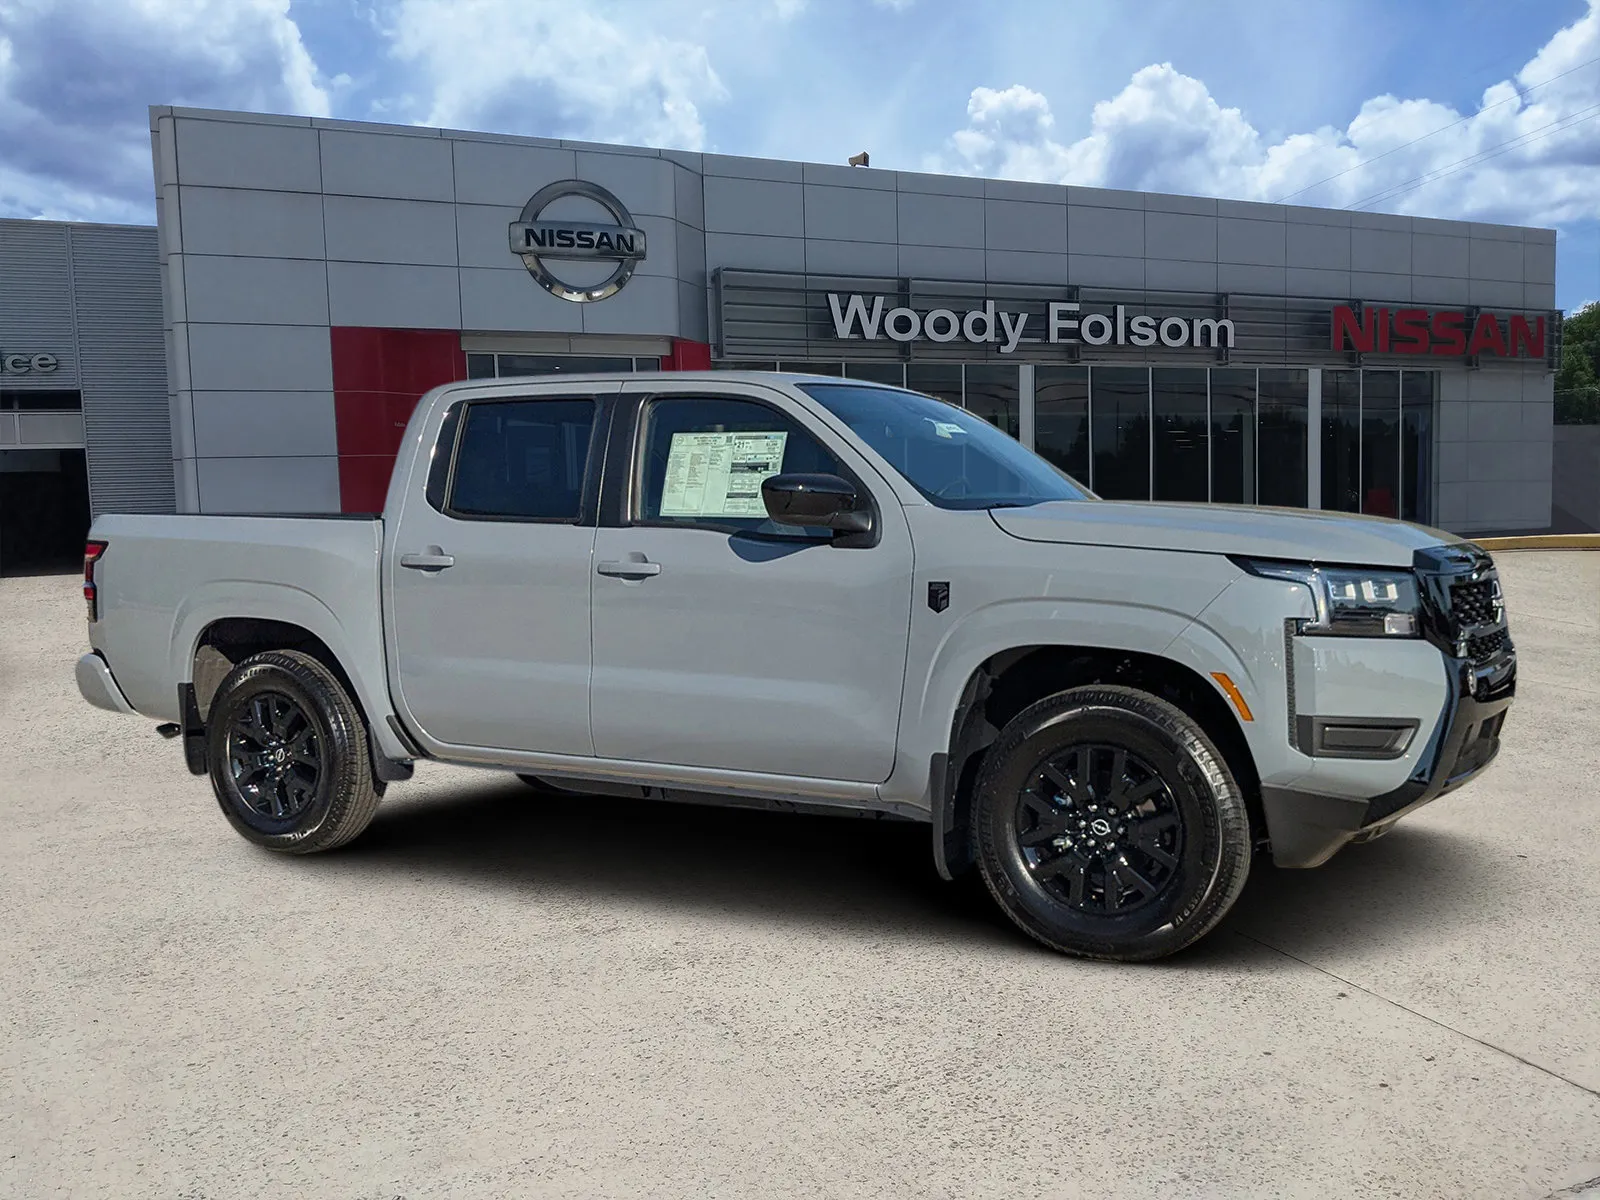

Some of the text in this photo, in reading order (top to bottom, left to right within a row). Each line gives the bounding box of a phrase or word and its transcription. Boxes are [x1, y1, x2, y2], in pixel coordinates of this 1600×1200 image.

[525, 228, 635, 252] NISSAN
[827, 293, 1235, 354] Woody Folsom
[1333, 305, 1545, 358] NISSAN
[0, 353, 57, 373] ce
